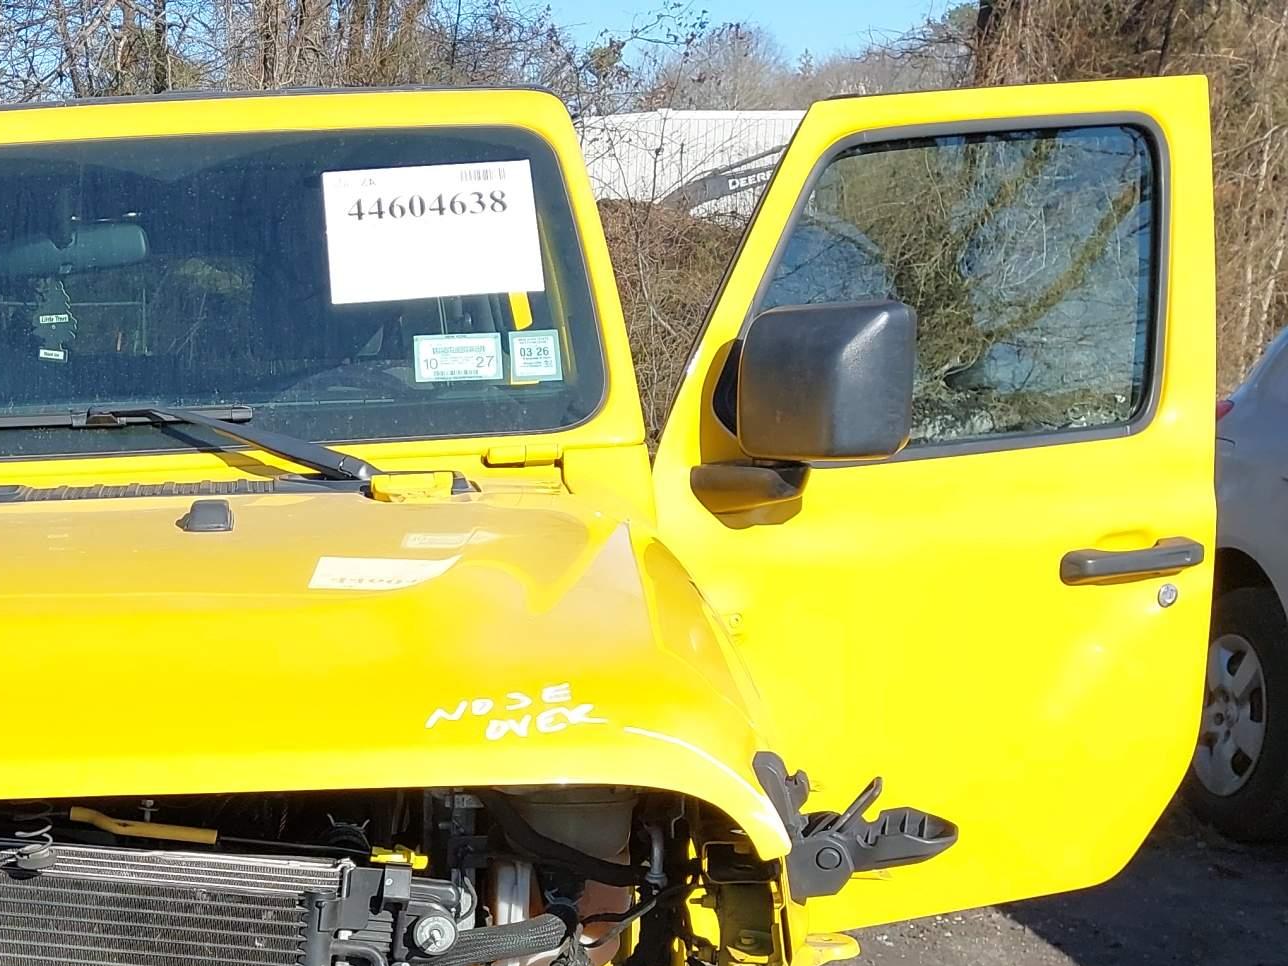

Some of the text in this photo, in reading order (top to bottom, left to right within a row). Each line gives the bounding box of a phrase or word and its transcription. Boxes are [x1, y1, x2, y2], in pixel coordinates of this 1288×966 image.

[347, 189, 509, 221] 44604638
[519, 346, 550, 357] 03 26
[423, 358, 439, 370] 10
[475, 355, 495, 368] 27
